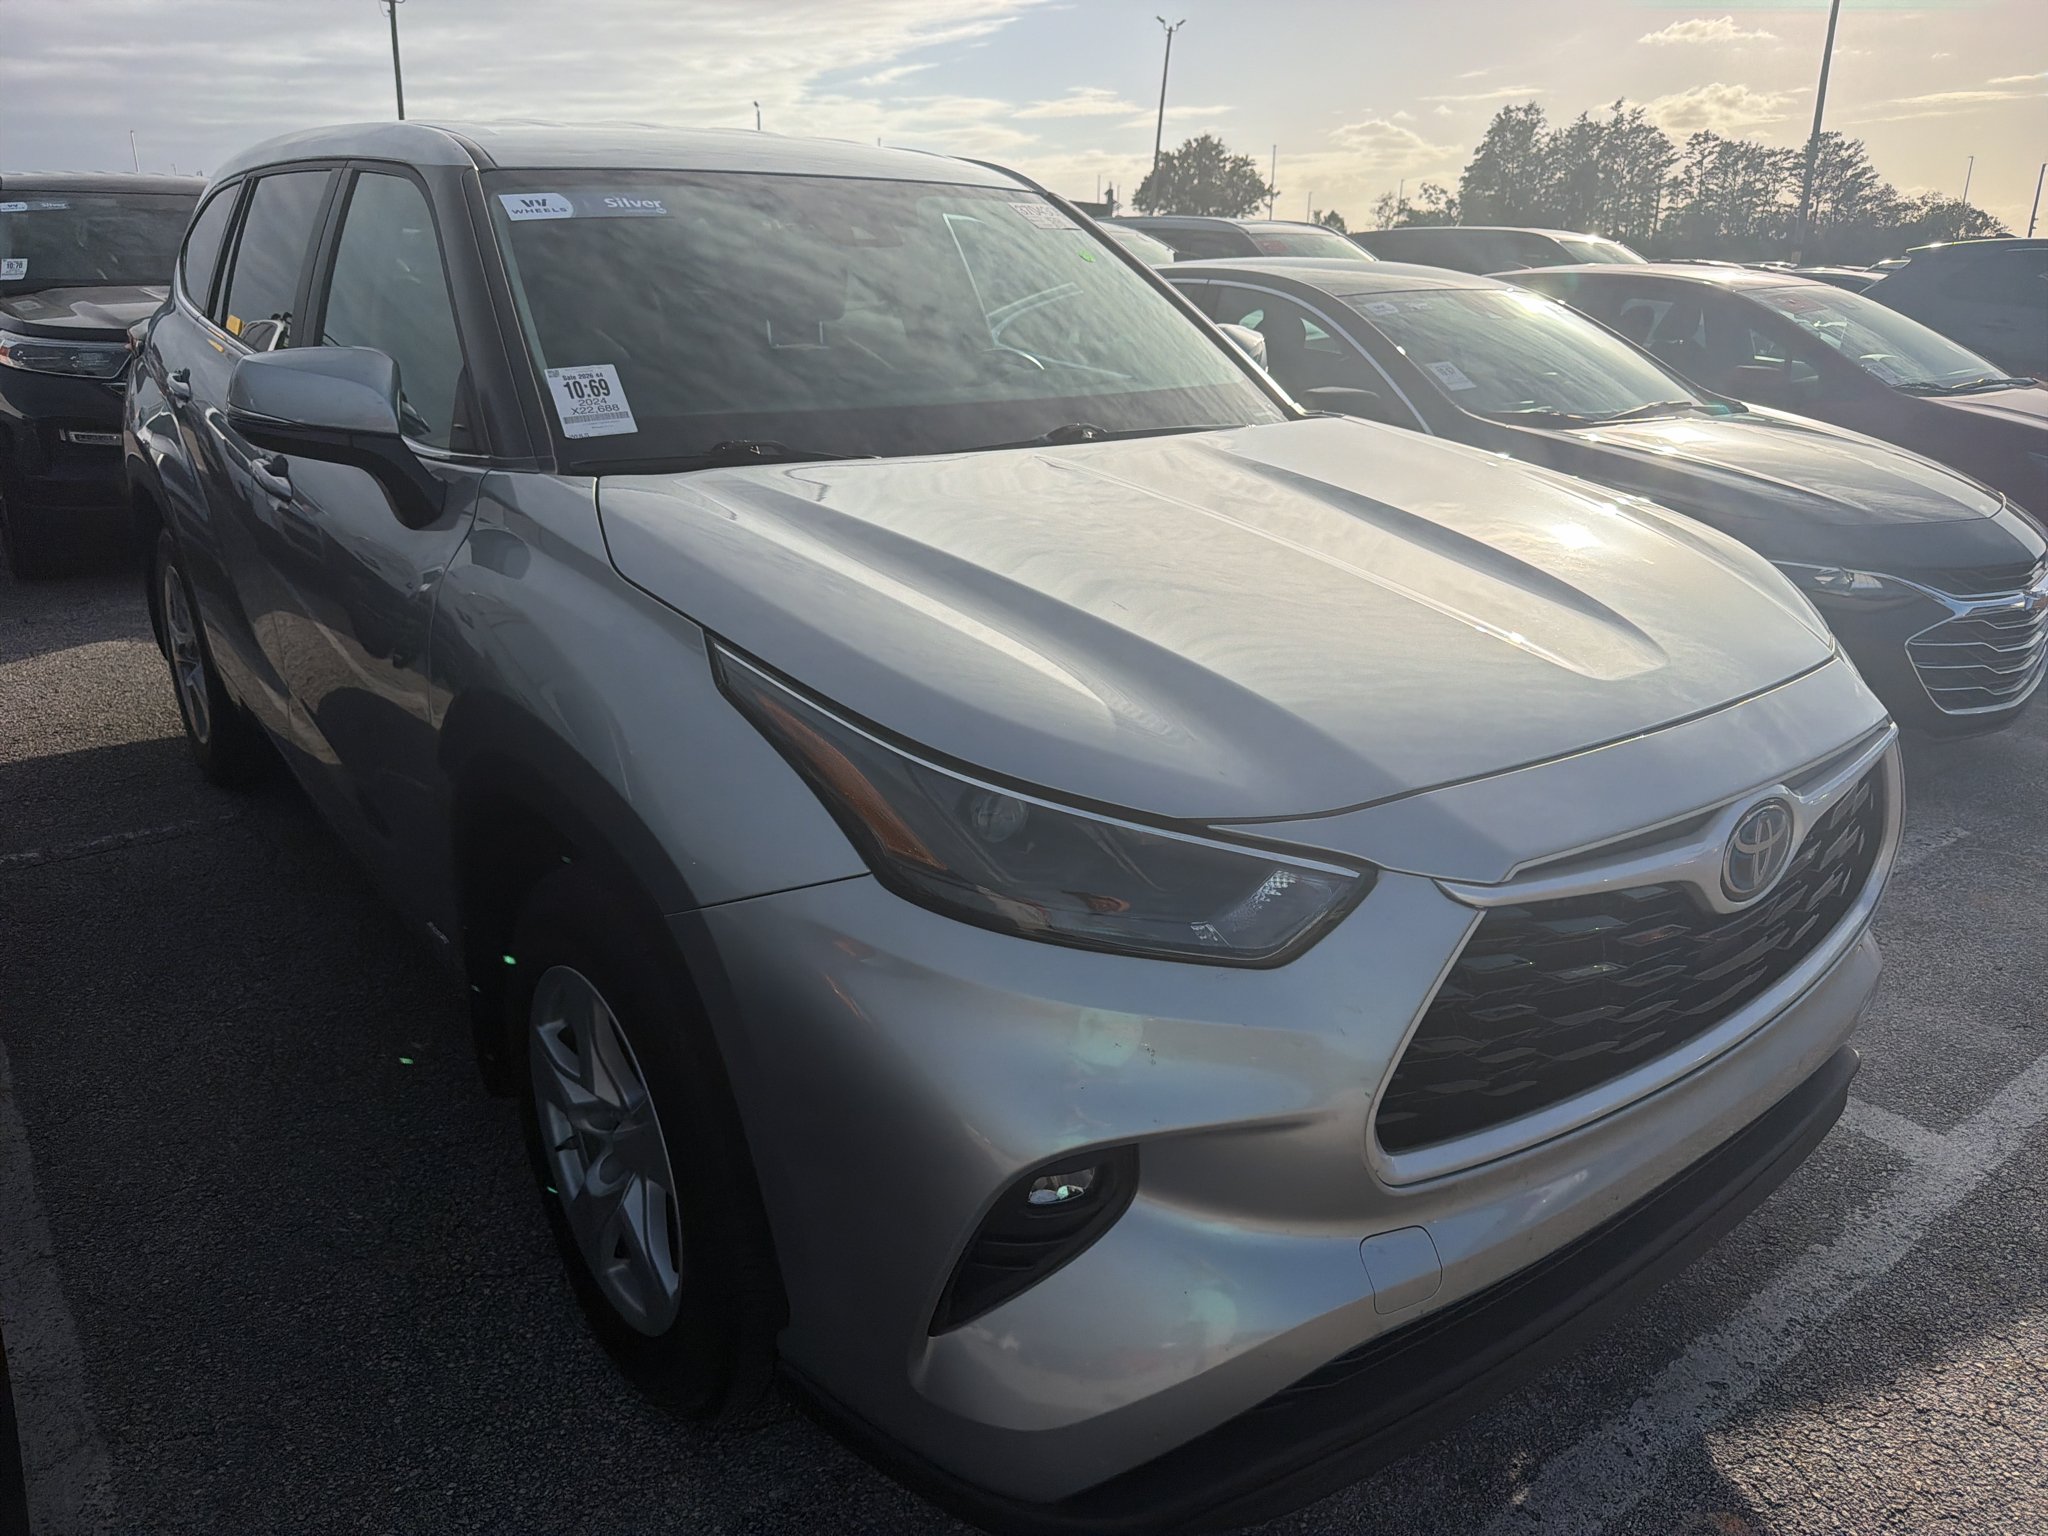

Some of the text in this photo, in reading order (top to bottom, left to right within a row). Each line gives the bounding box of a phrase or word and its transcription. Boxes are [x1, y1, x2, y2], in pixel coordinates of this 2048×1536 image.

[604, 197, 661, 208] Silver
[563, 379, 611, 399] 10:69
[578, 397, 607, 407] 2024
[571, 404, 620, 415] X22,688
